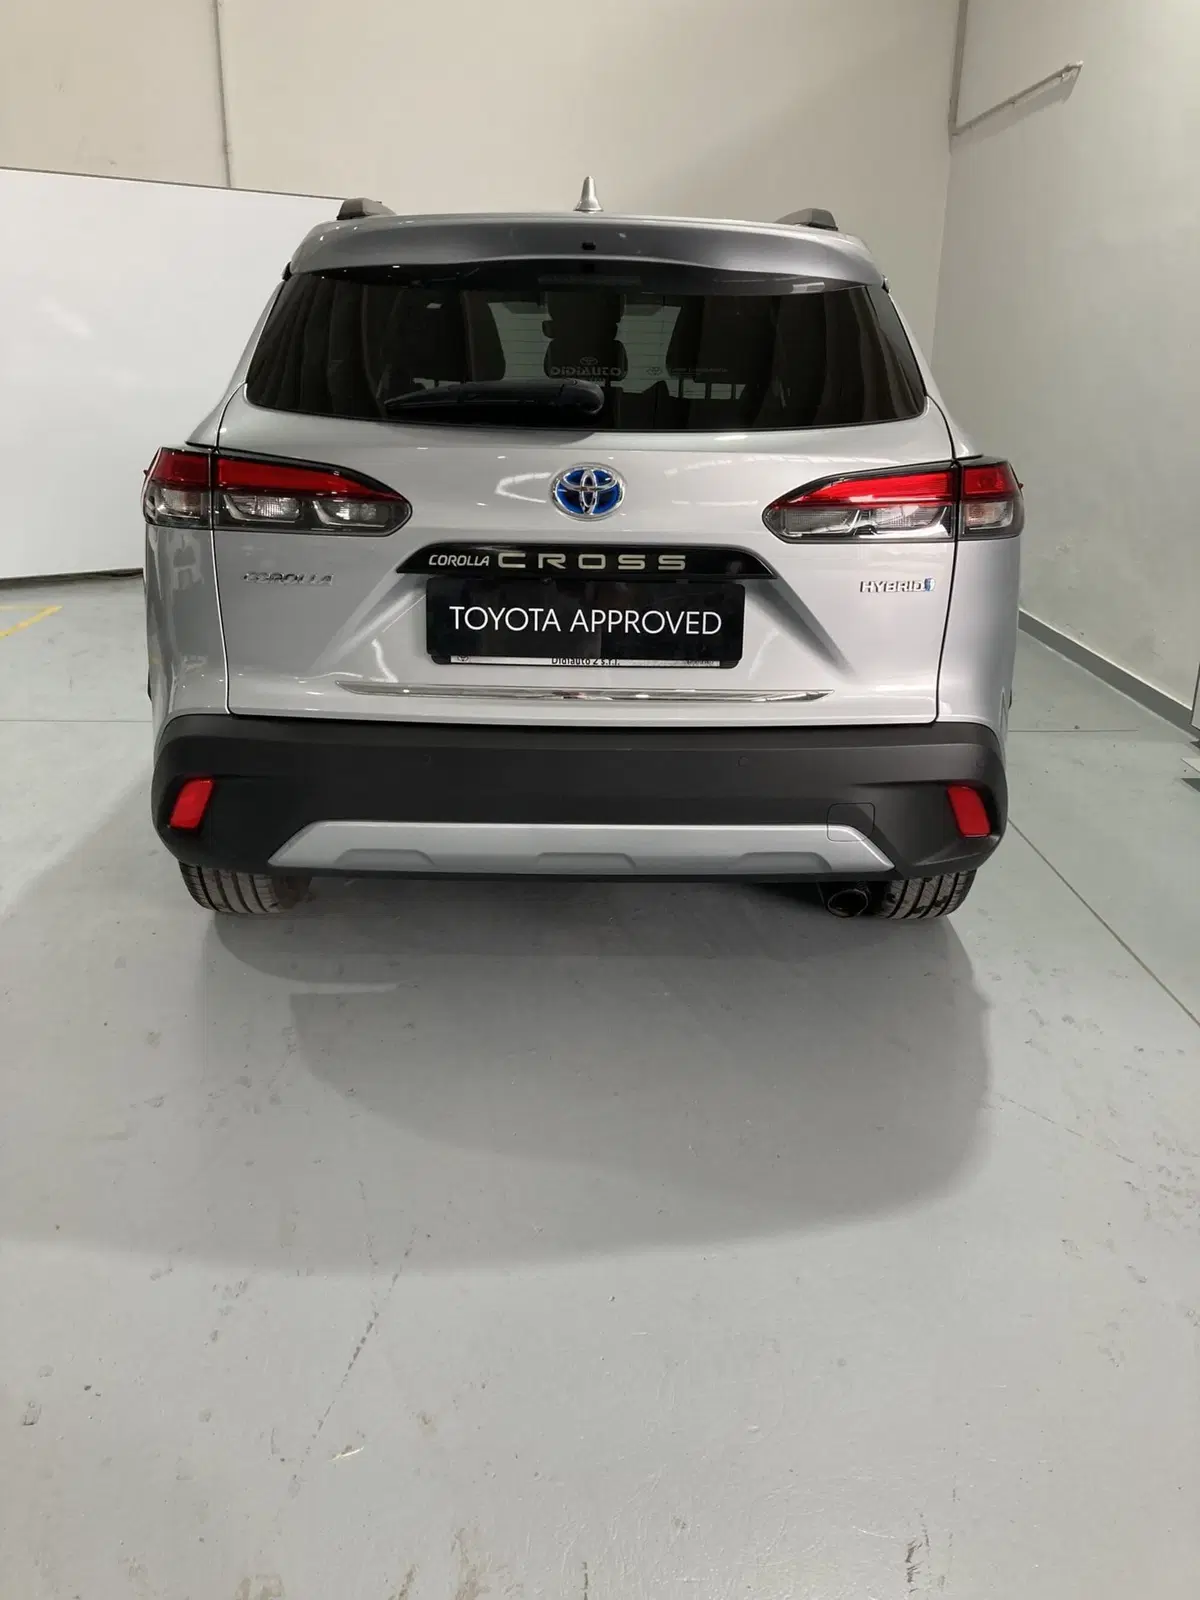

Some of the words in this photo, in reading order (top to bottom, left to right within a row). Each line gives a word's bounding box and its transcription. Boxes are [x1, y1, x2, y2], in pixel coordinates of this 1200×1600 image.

[428, 554, 490, 567] COROLLA
[498, 553, 687, 571] CROSS
[859, 580, 922, 593] HYBRID
[449, 606, 562, 633] TOYOTA
[569, 609, 722, 635] APPROVED
